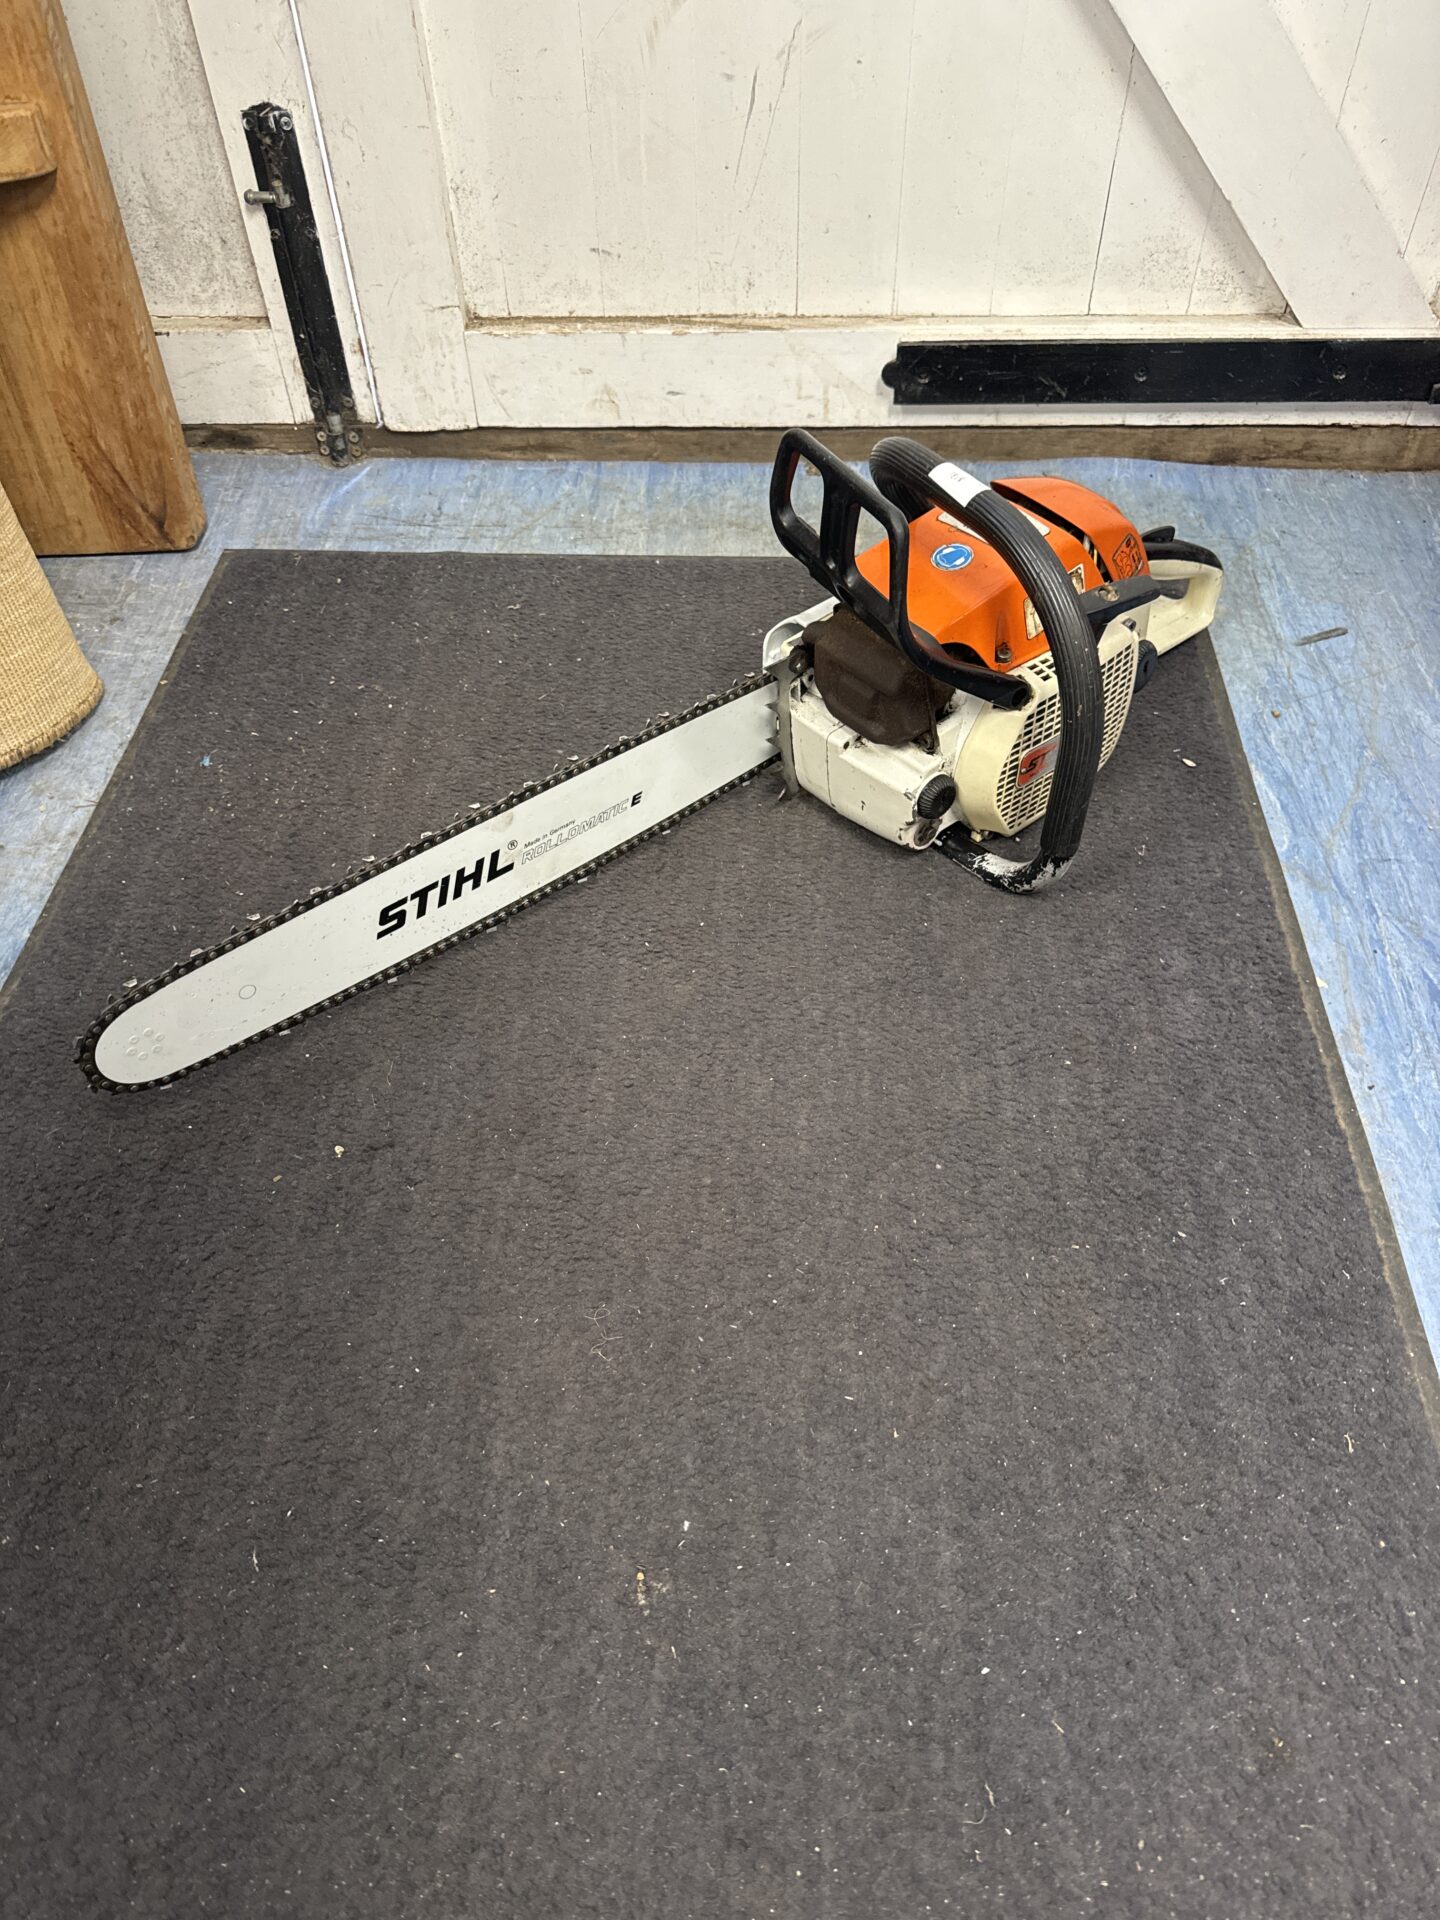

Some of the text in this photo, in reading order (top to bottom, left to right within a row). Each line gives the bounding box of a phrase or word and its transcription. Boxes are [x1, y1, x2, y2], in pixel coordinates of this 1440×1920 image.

[521, 791, 643, 865] ROLLOMATIC E
[524, 837, 541, 849] Made
[549, 819, 576, 836] Germany
[376, 849, 515, 940] STIHL
